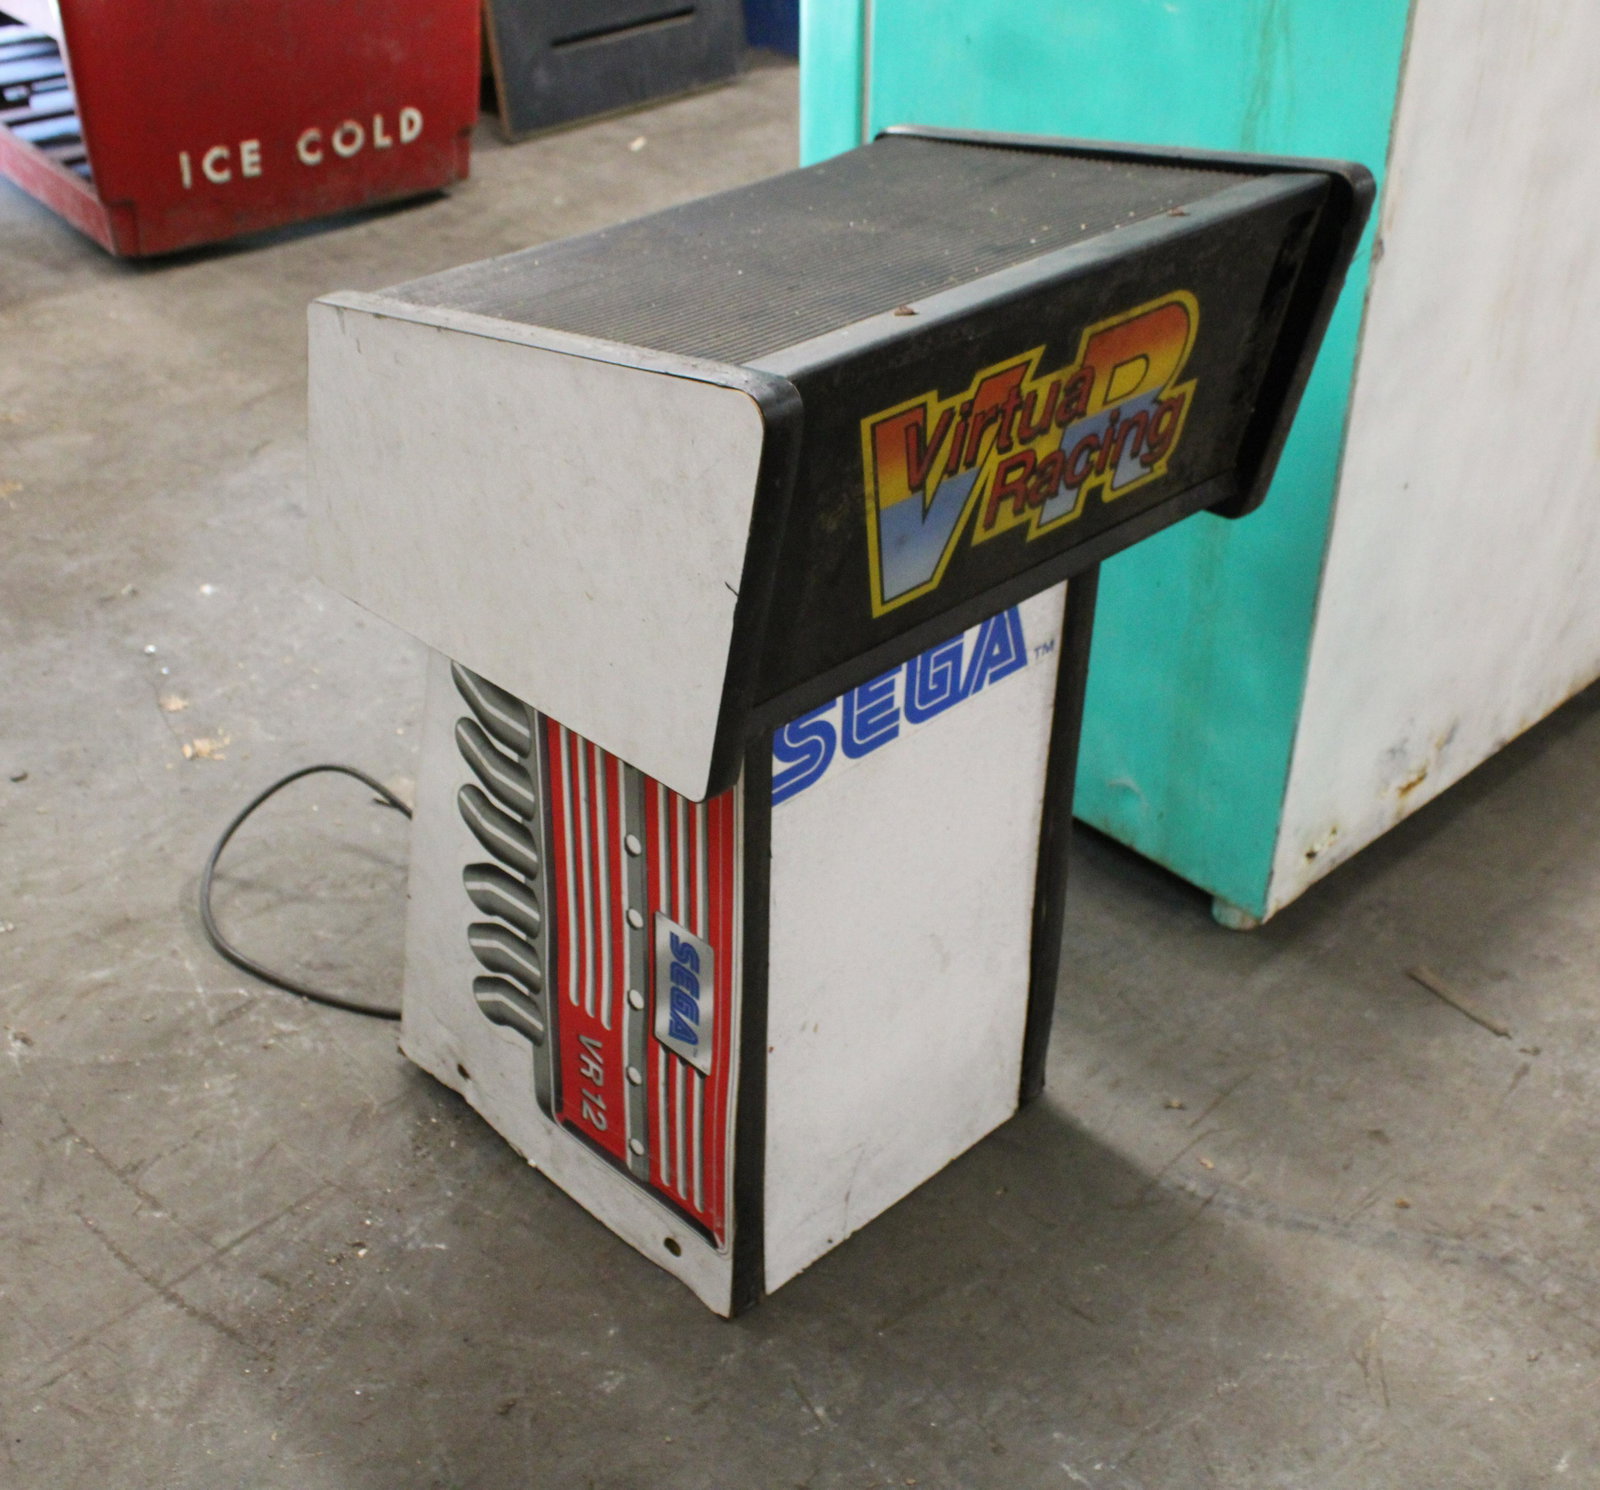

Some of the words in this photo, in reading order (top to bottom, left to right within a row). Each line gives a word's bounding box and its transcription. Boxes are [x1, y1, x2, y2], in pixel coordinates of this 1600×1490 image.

[179, 138, 262, 190] ICE
[297, 107, 423, 165] COLD
[904, 365, 1094, 490] Virtua
[983, 394, 1187, 532] Racing
[771, 604, 1028, 808] SEGA
[669, 931, 700, 1046] SEGA
[579, 1034, 604, 1087] VR
[582, 1088, 608, 1132] 12
